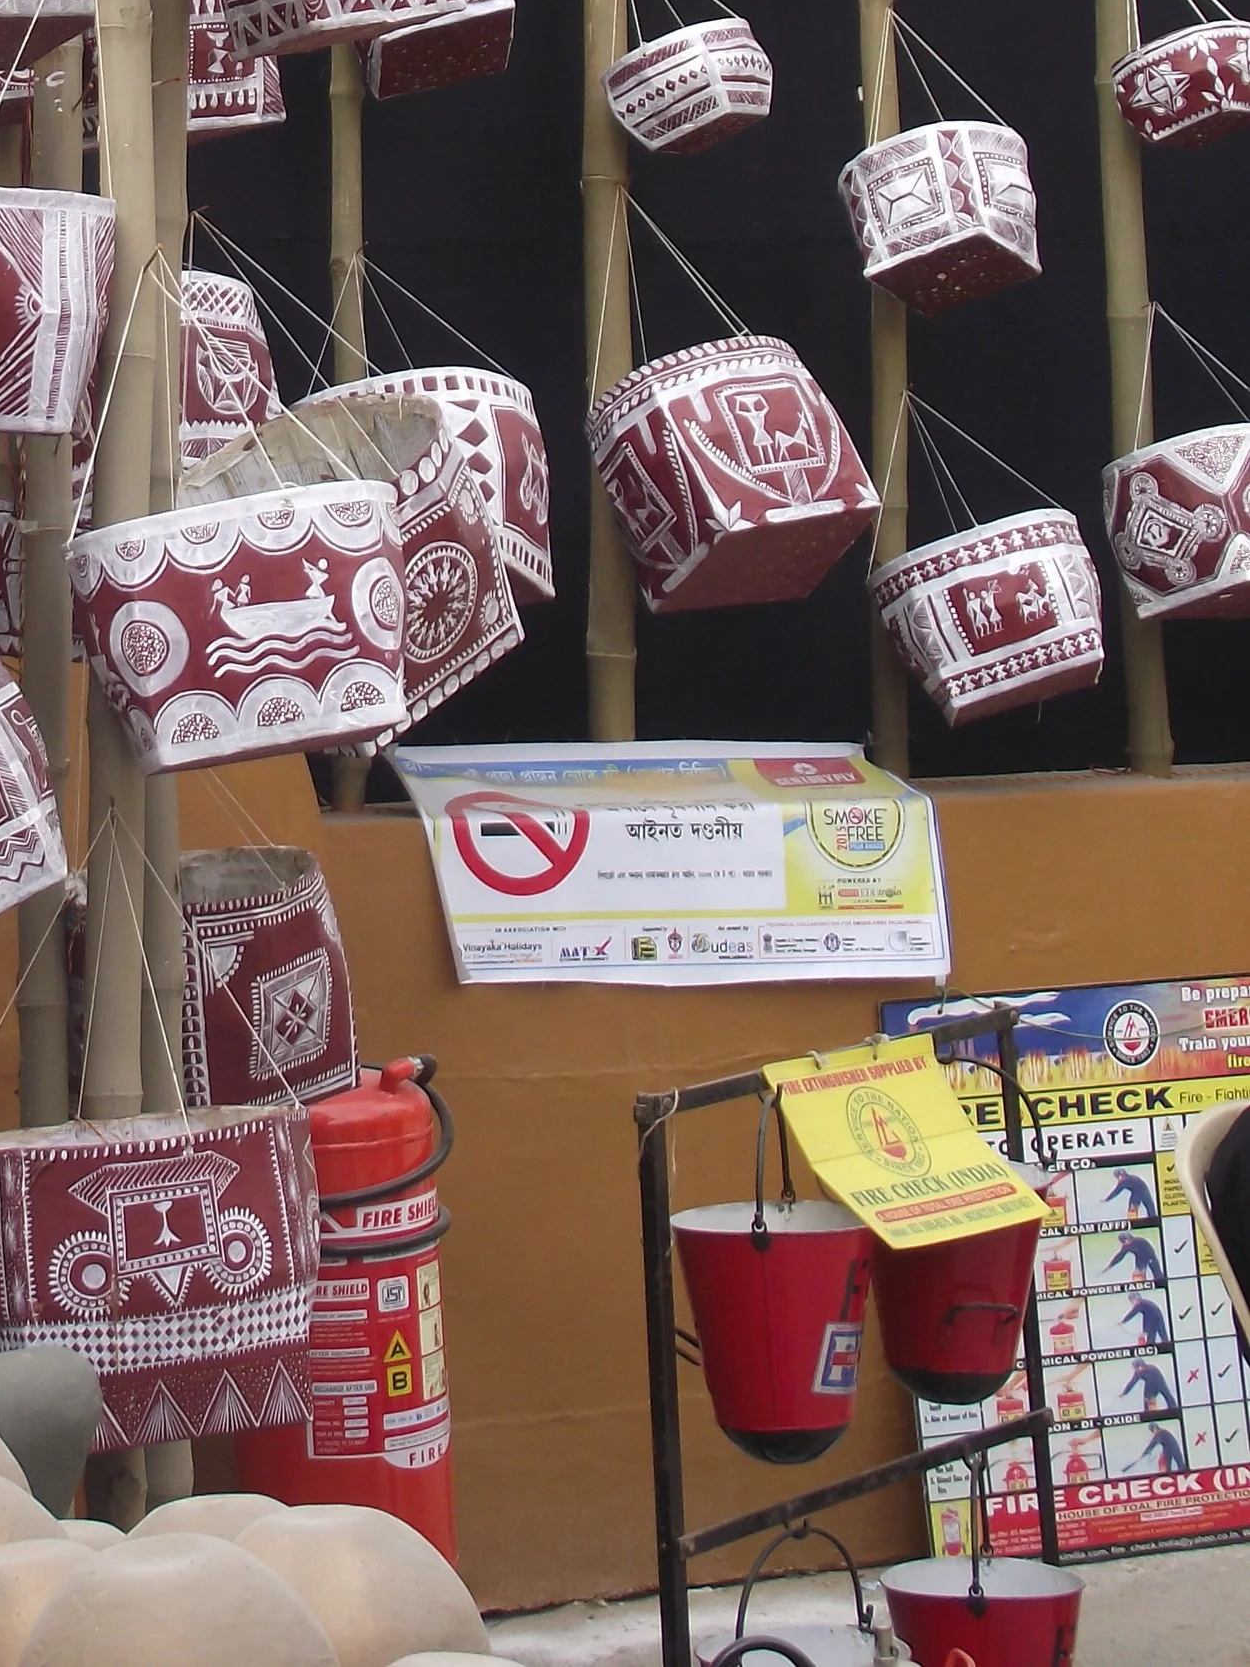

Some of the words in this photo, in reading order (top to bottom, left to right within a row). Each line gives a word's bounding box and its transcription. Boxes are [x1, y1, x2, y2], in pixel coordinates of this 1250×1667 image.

[823, 807, 886, 826] SMOKE
[836, 826, 848, 850] 2015
[848, 825, 884, 842] FREE
[504, 942, 543, 952] Holidays
[1181, 986, 1201, 1002] Be
[1178, 1035, 1217, 1052] Train
[802, 1070, 870, 1092] EXTINGUISHER
[867, 1062, 916, 1080] SUPPLIED
[1030, 1085, 1175, 1121] CHECK
[1179, 1091, 1203, 1105] Fire
[1030, 1128, 1134, 1154] OPERATE
[850, 1186, 893, 1208] FIRE
[891, 1173, 951, 1200] CHECK
[947, 1161, 1010, 1190] (INDIA)
[362, 1207, 402, 1229] FIRE
[1064, 1223, 1095, 1235] FOAM
[1097, 1220, 1132, 1232] (AFFF)
[332, 1283, 368, 1296] SHIELD
[1072, 1284, 1122, 1297] POWDER
[1124, 1280, 1156, 1292] (ABC)
[391, 1339, 406, 1358] A
[1080, 1349, 1131, 1362] POWDER
[1134, 1346, 1159, 1357] (BC)
[393, 1371, 408, 1391] B
[1081, 1419, 1095, 1430] DI
[1104, 1413, 1141, 1427] OXIDE
[408, 1442, 443, 1466] FIRE
[1079, 1472, 1203, 1505] CHECK
[1058, 1507, 1100, 1521] HOUSE
[1103, 1504, 1119, 1515] OF
[1123, 1501, 1152, 1514] TOAL
[1156, 1498, 1183, 1510] FIRE
